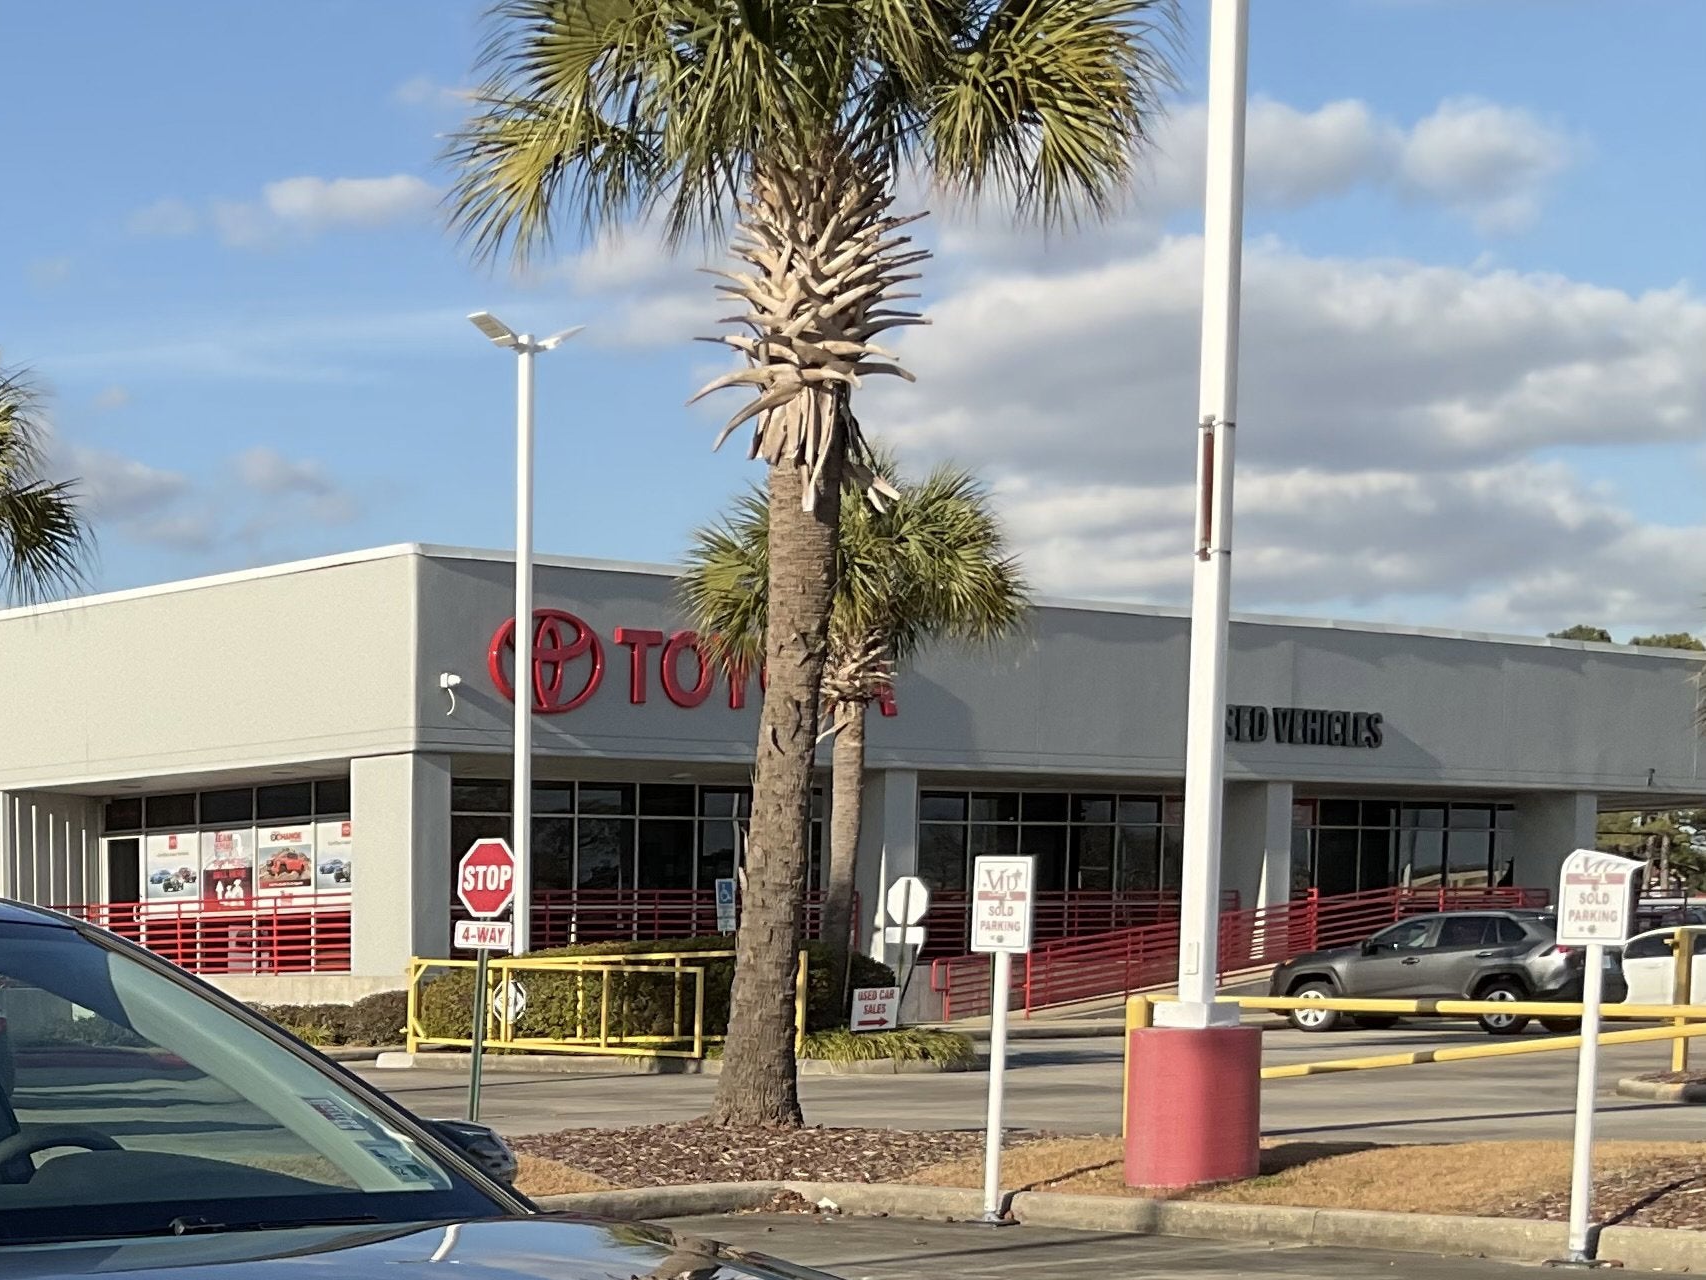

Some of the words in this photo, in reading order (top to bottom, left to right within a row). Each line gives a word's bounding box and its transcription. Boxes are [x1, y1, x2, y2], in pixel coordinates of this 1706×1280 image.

[1272, 707, 1383, 749] VEHICLES
[463, 864, 512, 892] STOP
[1579, 892, 1610, 905] SOLD
[988, 905, 1014, 917] SOLD
[1568, 910, 1618, 922] PARKING
[980, 920, 1021, 932] PARKING
[462, 926, 506, 944] 4-WAY
[858, 990, 878, 1001] USED
[879, 989, 895, 1000] CAR
[863, 1003, 887, 1015] SALES
